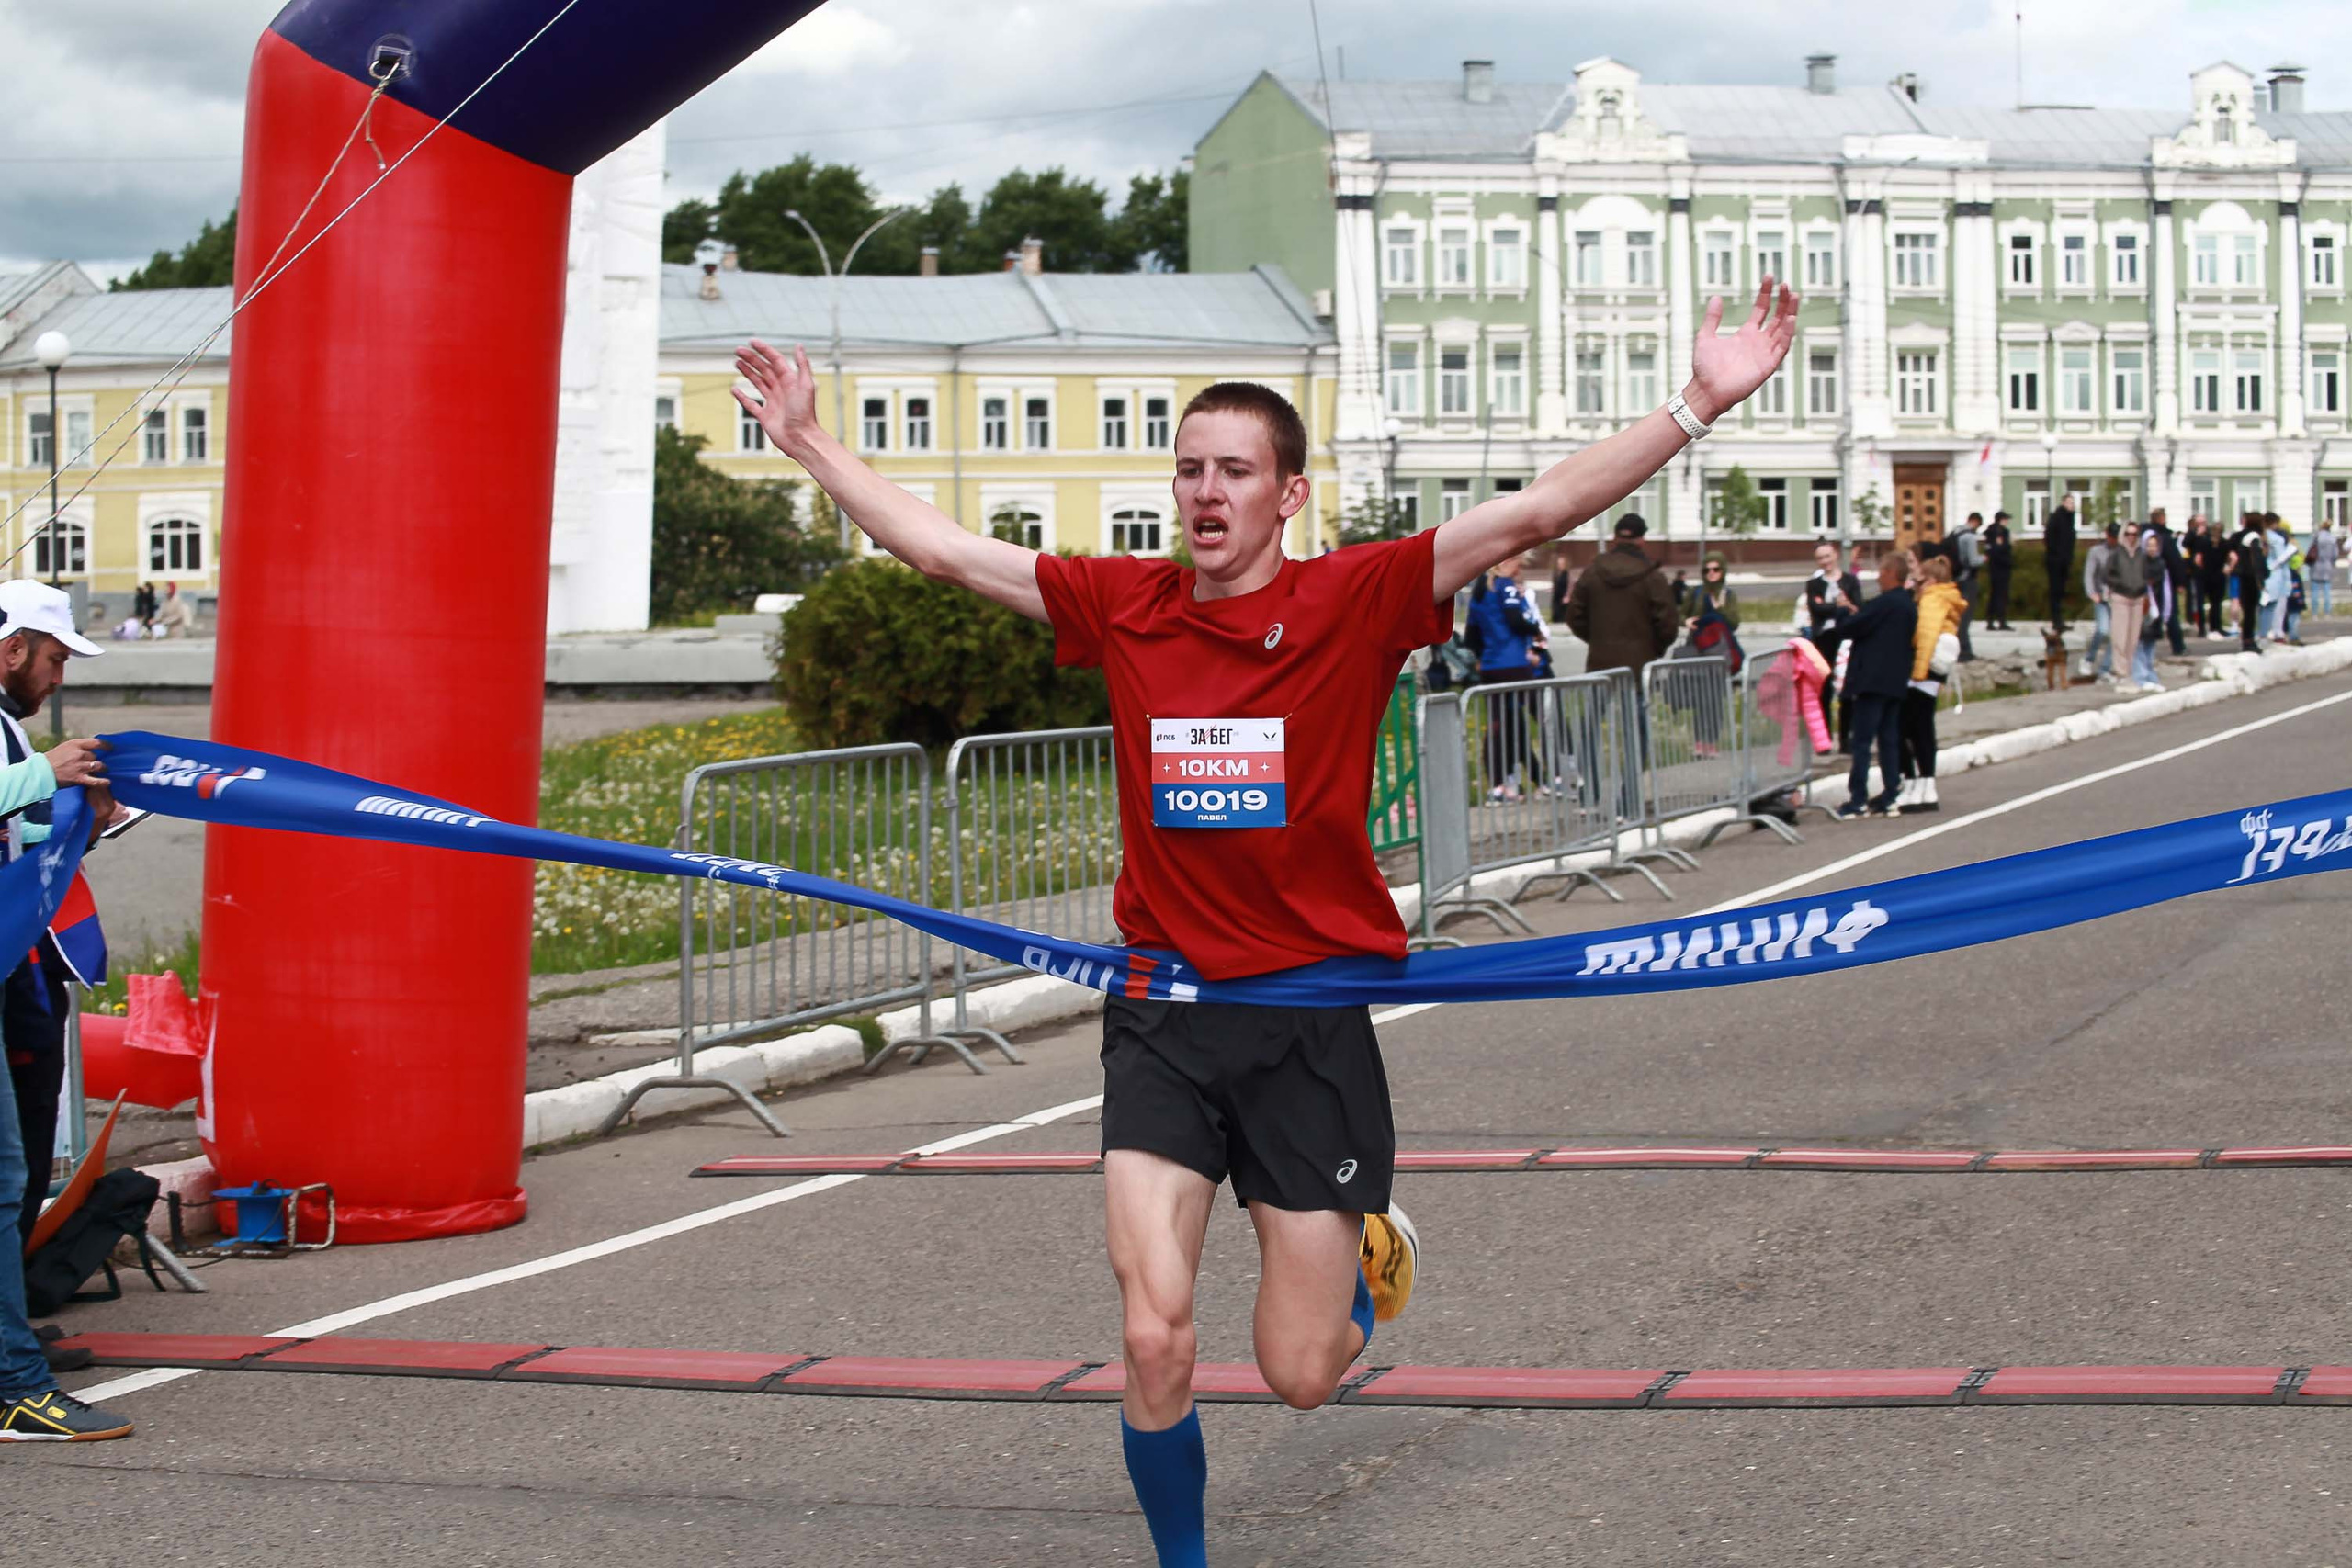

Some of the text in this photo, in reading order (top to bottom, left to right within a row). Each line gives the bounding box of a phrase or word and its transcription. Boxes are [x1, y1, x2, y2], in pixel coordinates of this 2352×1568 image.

[1179, 759, 1249, 777] 10КМ
[1164, 789, 1268, 812] 10019
[1576, 899, 1889, 976] ФИНИШ
